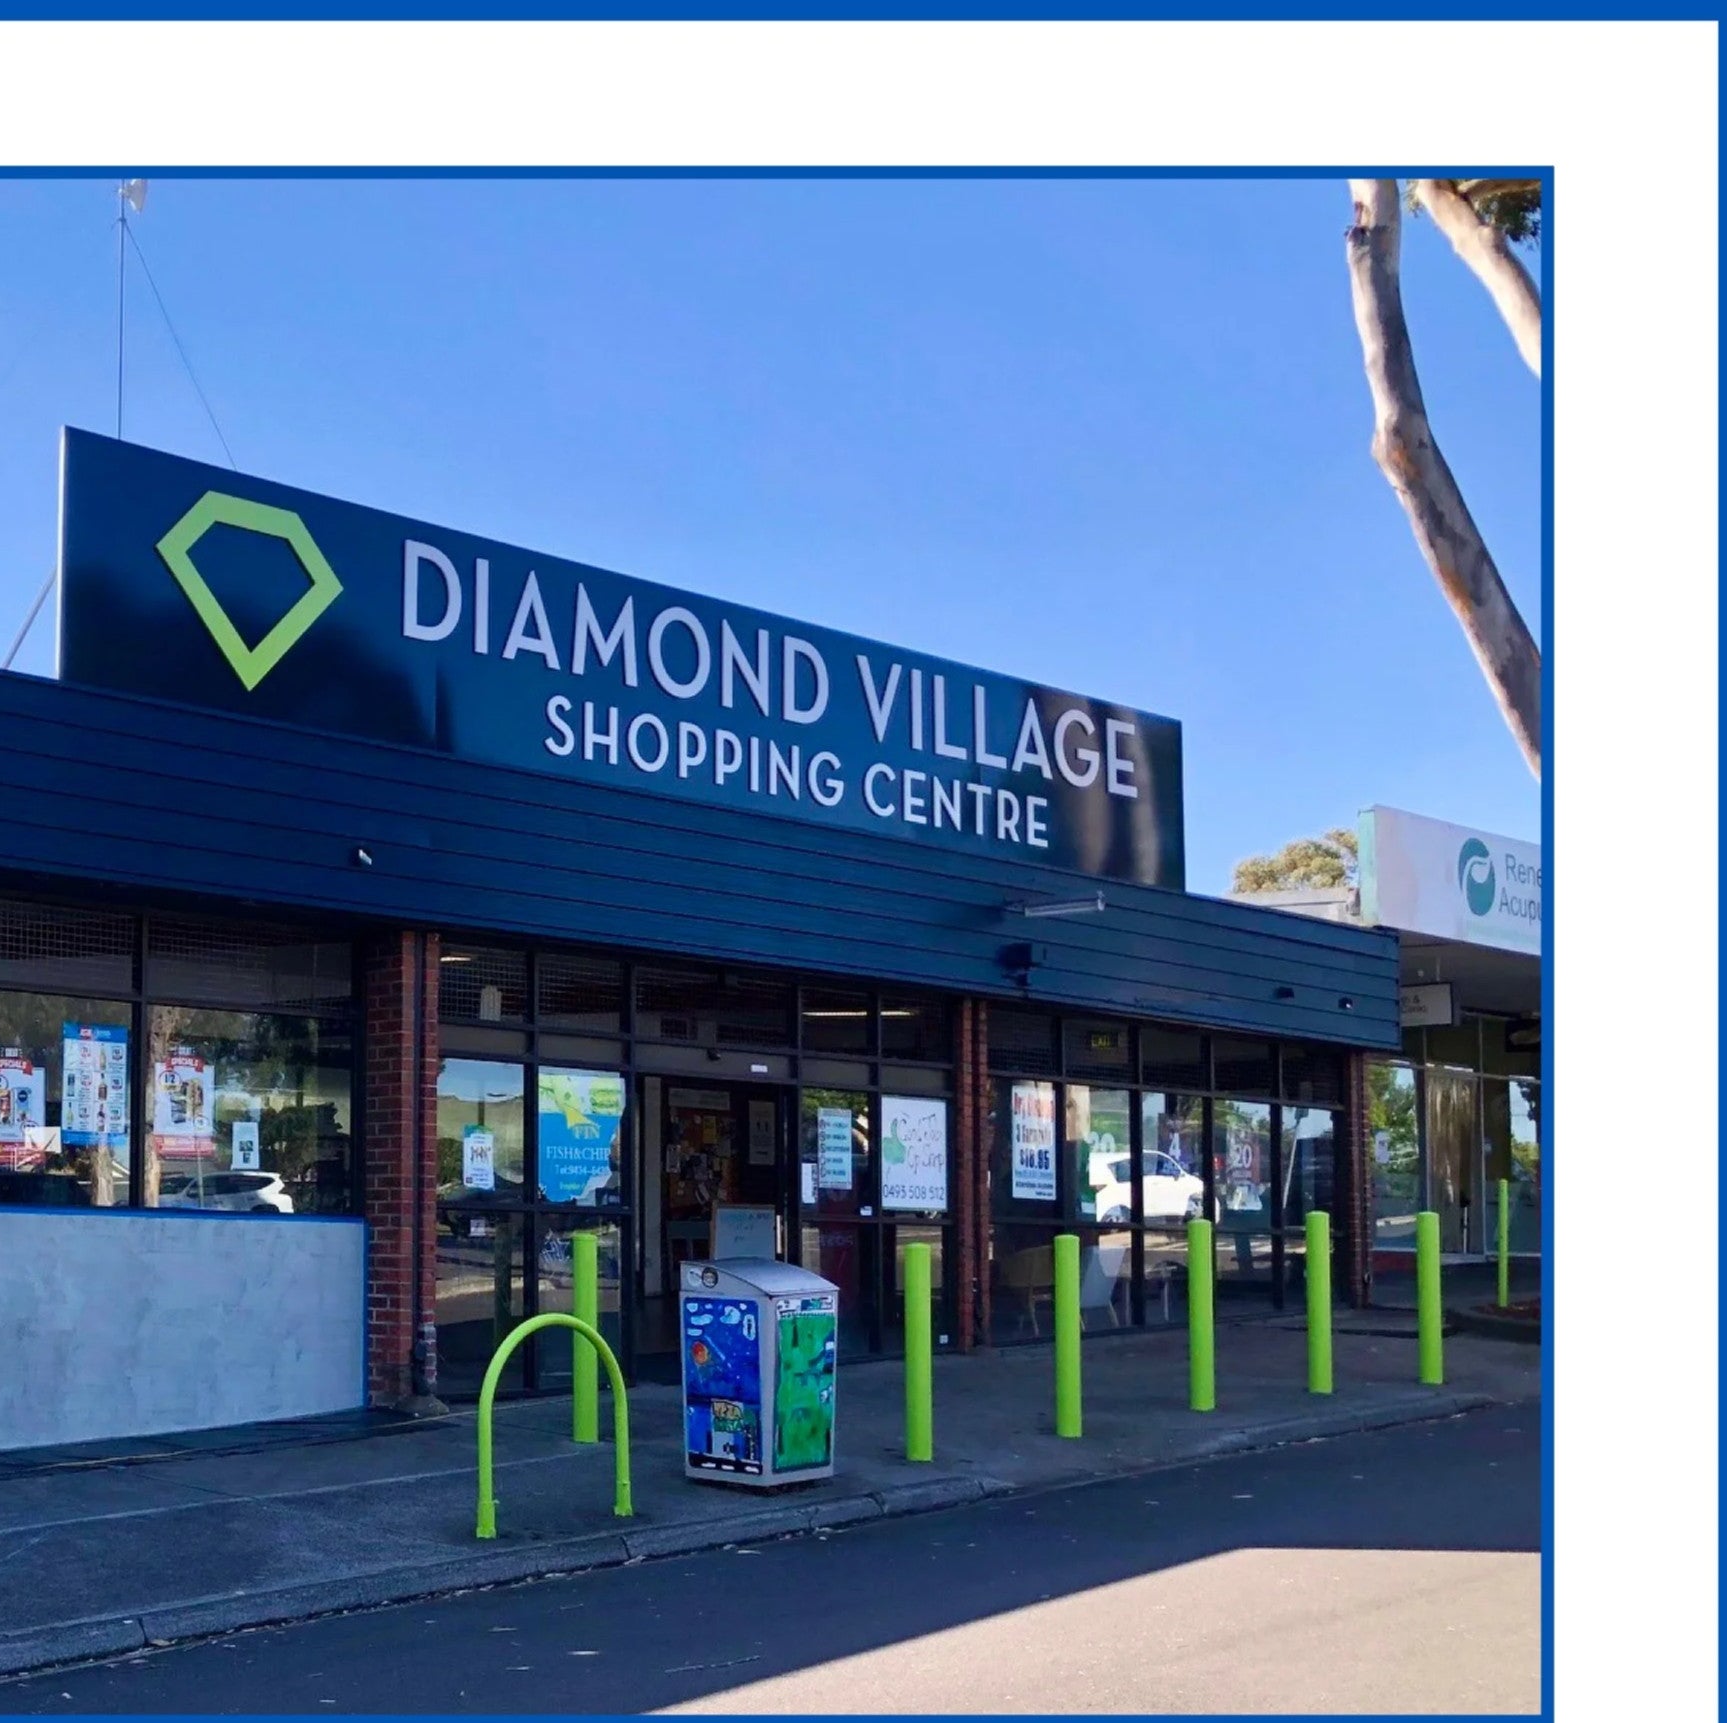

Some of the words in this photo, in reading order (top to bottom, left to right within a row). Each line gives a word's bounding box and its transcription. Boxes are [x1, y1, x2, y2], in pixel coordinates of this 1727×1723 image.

[403, 539, 829, 724] DIAMOND
[856, 655, 1138, 799] VILLAGE
[544, 695, 844, 807] SHOPPING
[864, 762, 1049, 848] CENTRE
